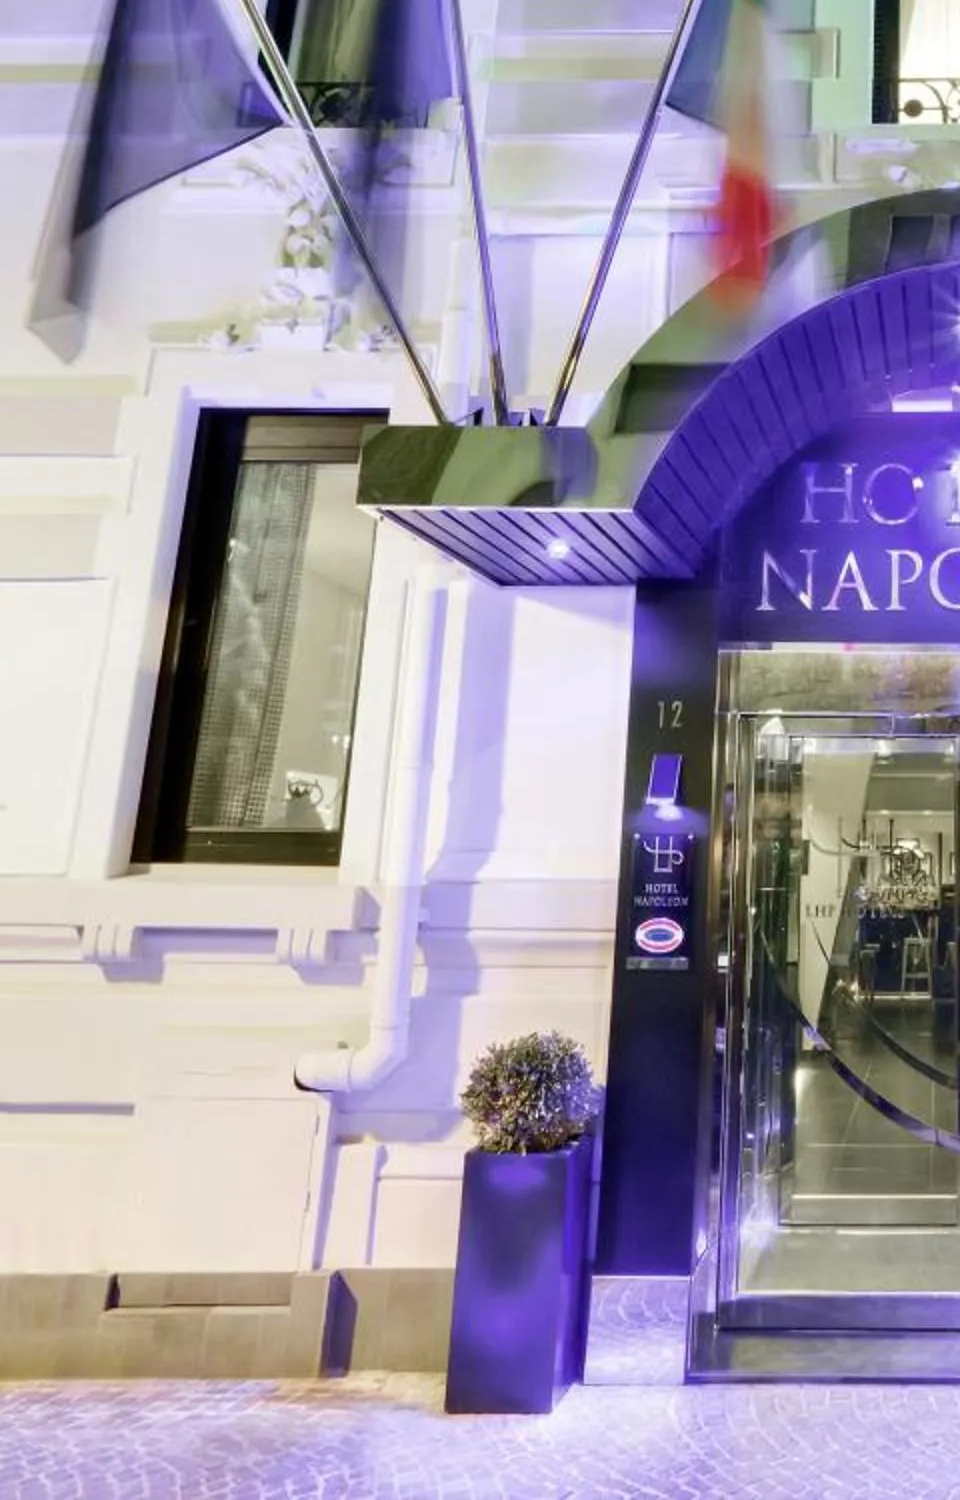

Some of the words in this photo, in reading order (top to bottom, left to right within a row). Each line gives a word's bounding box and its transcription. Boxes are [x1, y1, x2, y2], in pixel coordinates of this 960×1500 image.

[657, 701, 683, 728] 12
[644, 883, 679, 894] HOTEL
[633, 895, 689, 908] NAPOLEON
